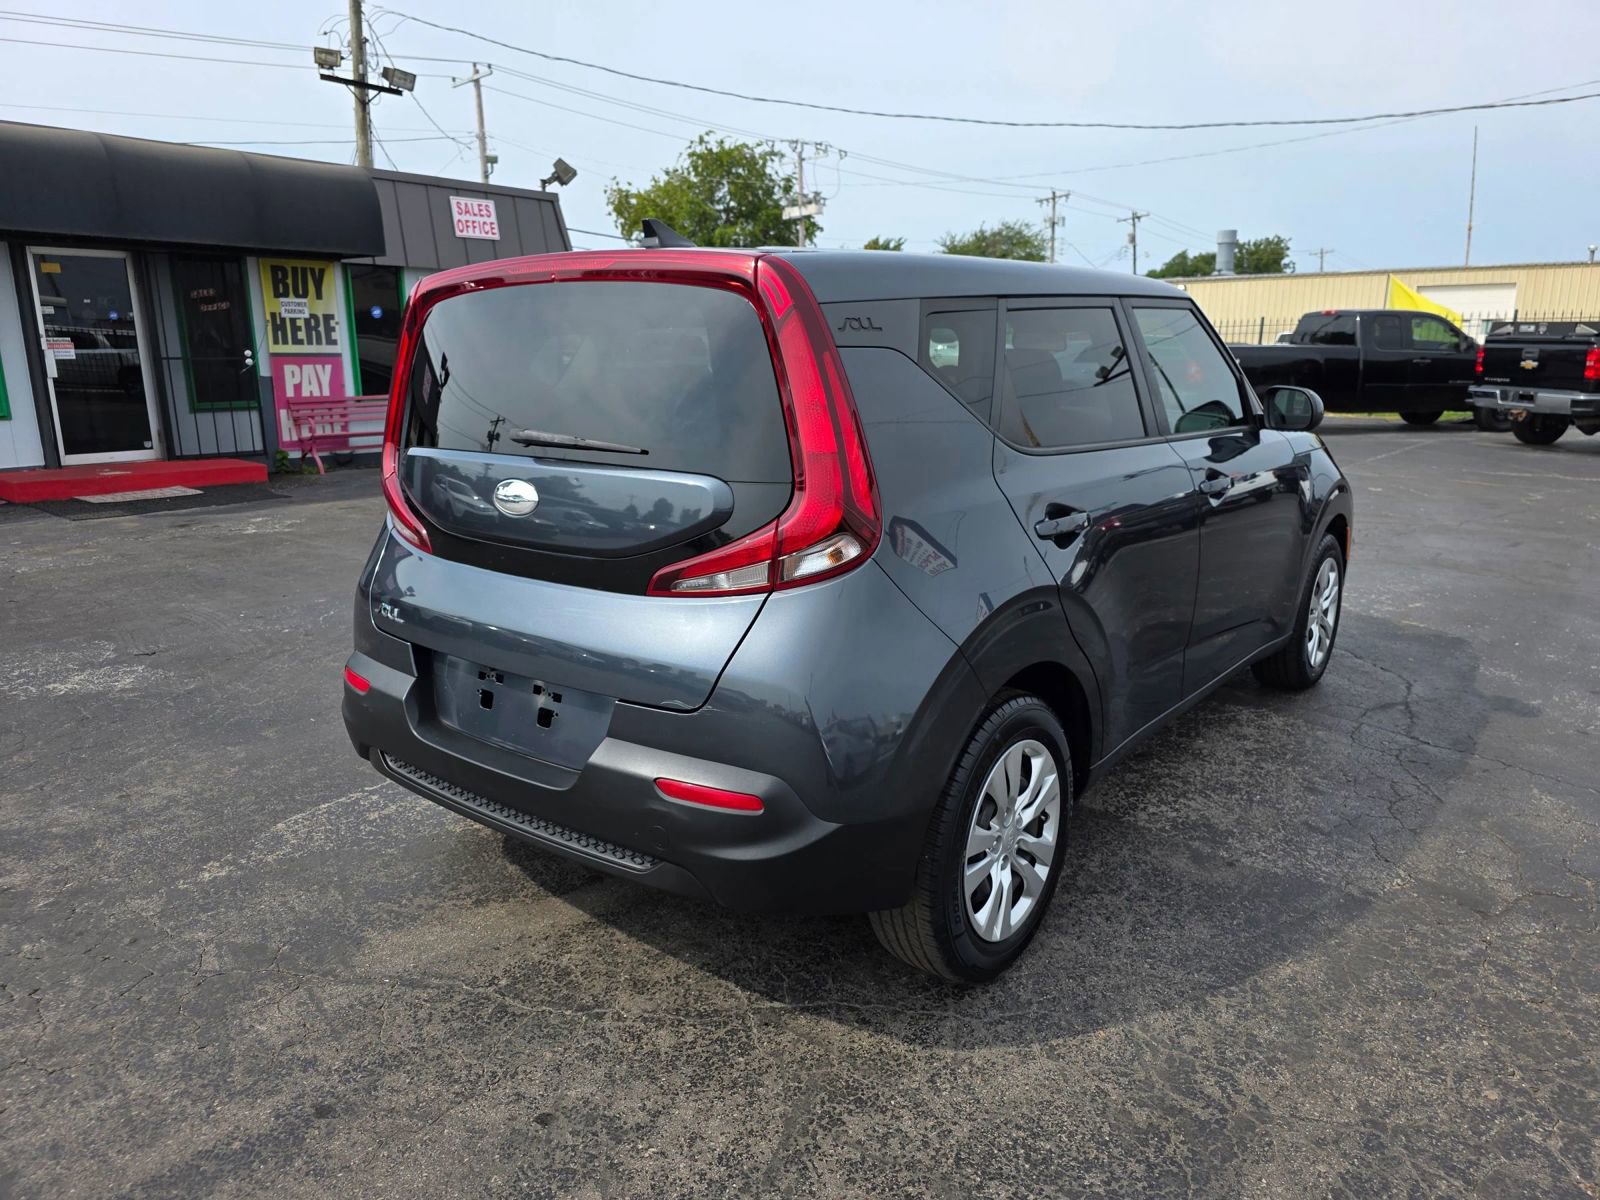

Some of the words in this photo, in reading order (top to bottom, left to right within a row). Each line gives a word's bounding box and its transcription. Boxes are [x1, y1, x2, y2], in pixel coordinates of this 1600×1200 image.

[455, 201, 492, 218] SALES
[456, 218, 497, 236] OFFICE
[271, 264, 326, 301] BUY
[270, 312, 338, 346] HERE
[283, 364, 332, 397] PAY
